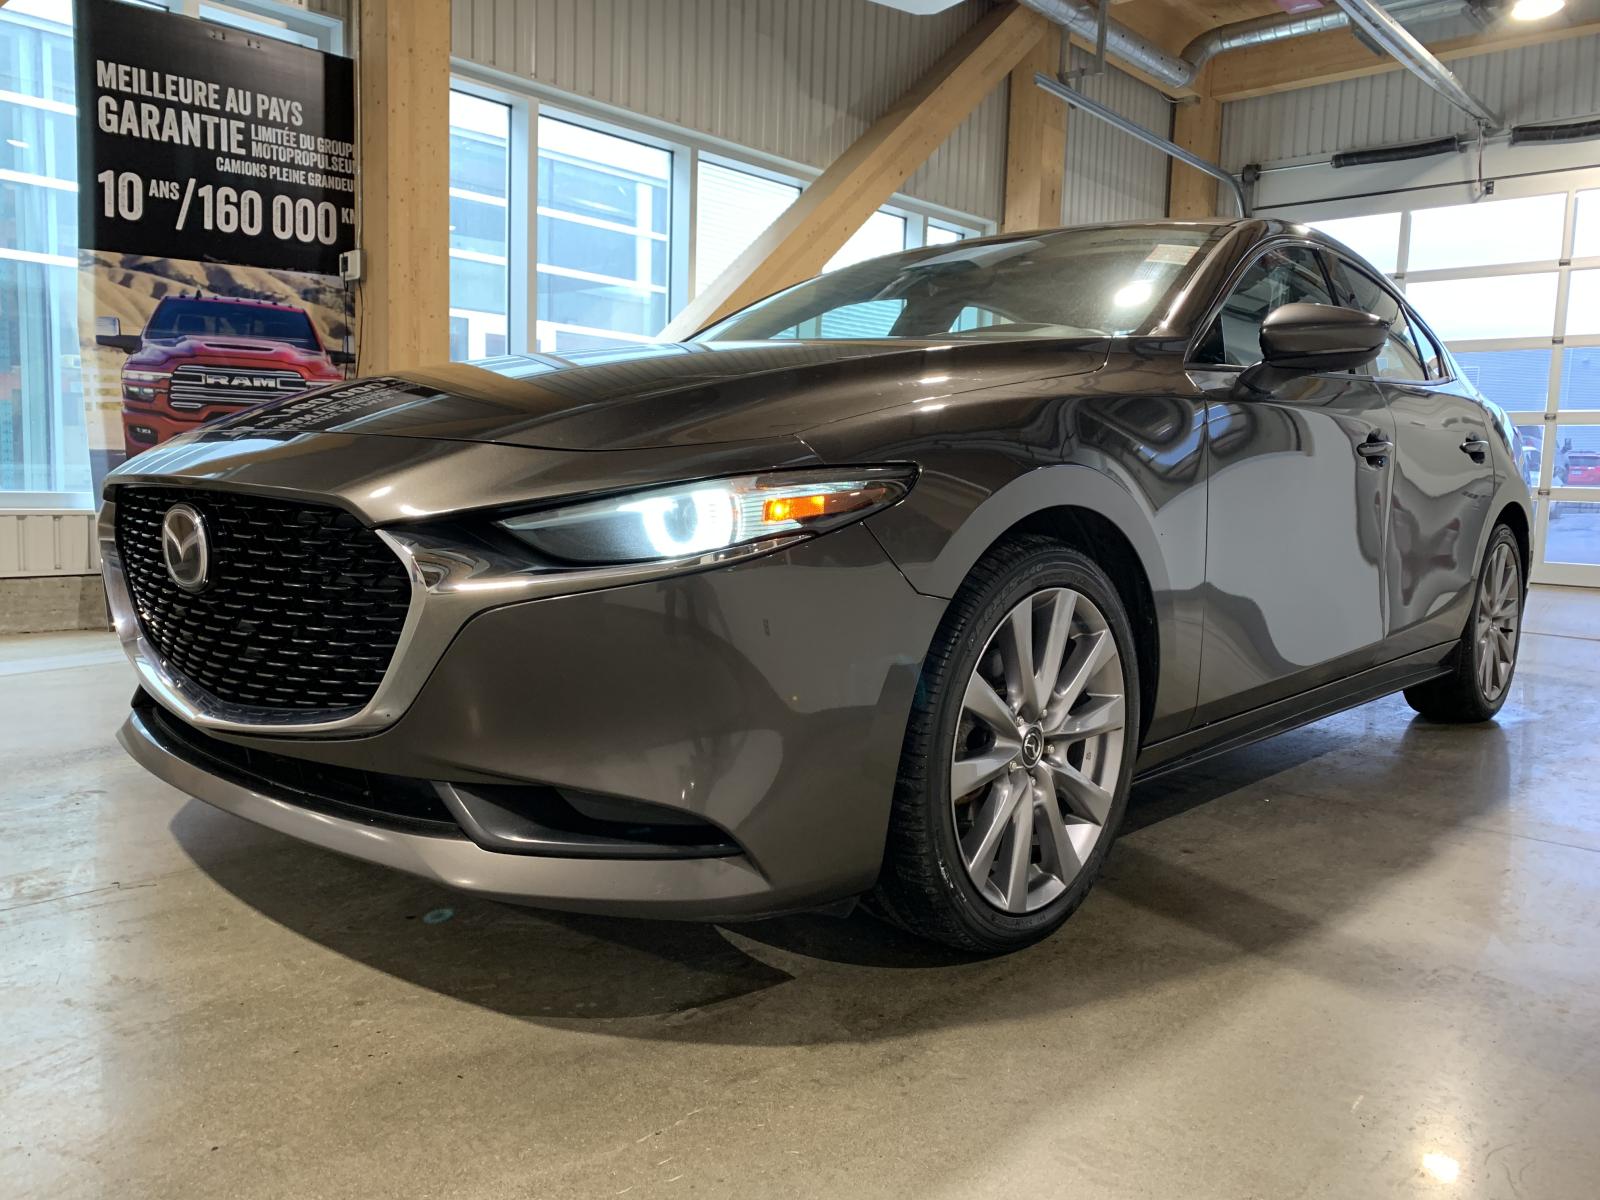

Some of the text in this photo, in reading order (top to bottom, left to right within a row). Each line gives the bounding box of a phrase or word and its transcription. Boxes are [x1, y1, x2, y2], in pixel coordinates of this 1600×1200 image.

[97, 60, 303, 126] MEILLEURE AU PAYS
[98, 96, 246, 155] GARANTIE
[251, 124, 297, 147] LIMITÉE
[299, 133, 315, 151] DU
[216, 157, 354, 192] CAMIONS PLEINE GRANDEU
[251, 141, 354, 174] MOTOPROPULSEU
[97, 170, 143, 221] 10
[272, 194, 338, 245] 000
[206, 374, 276, 388] RAM
